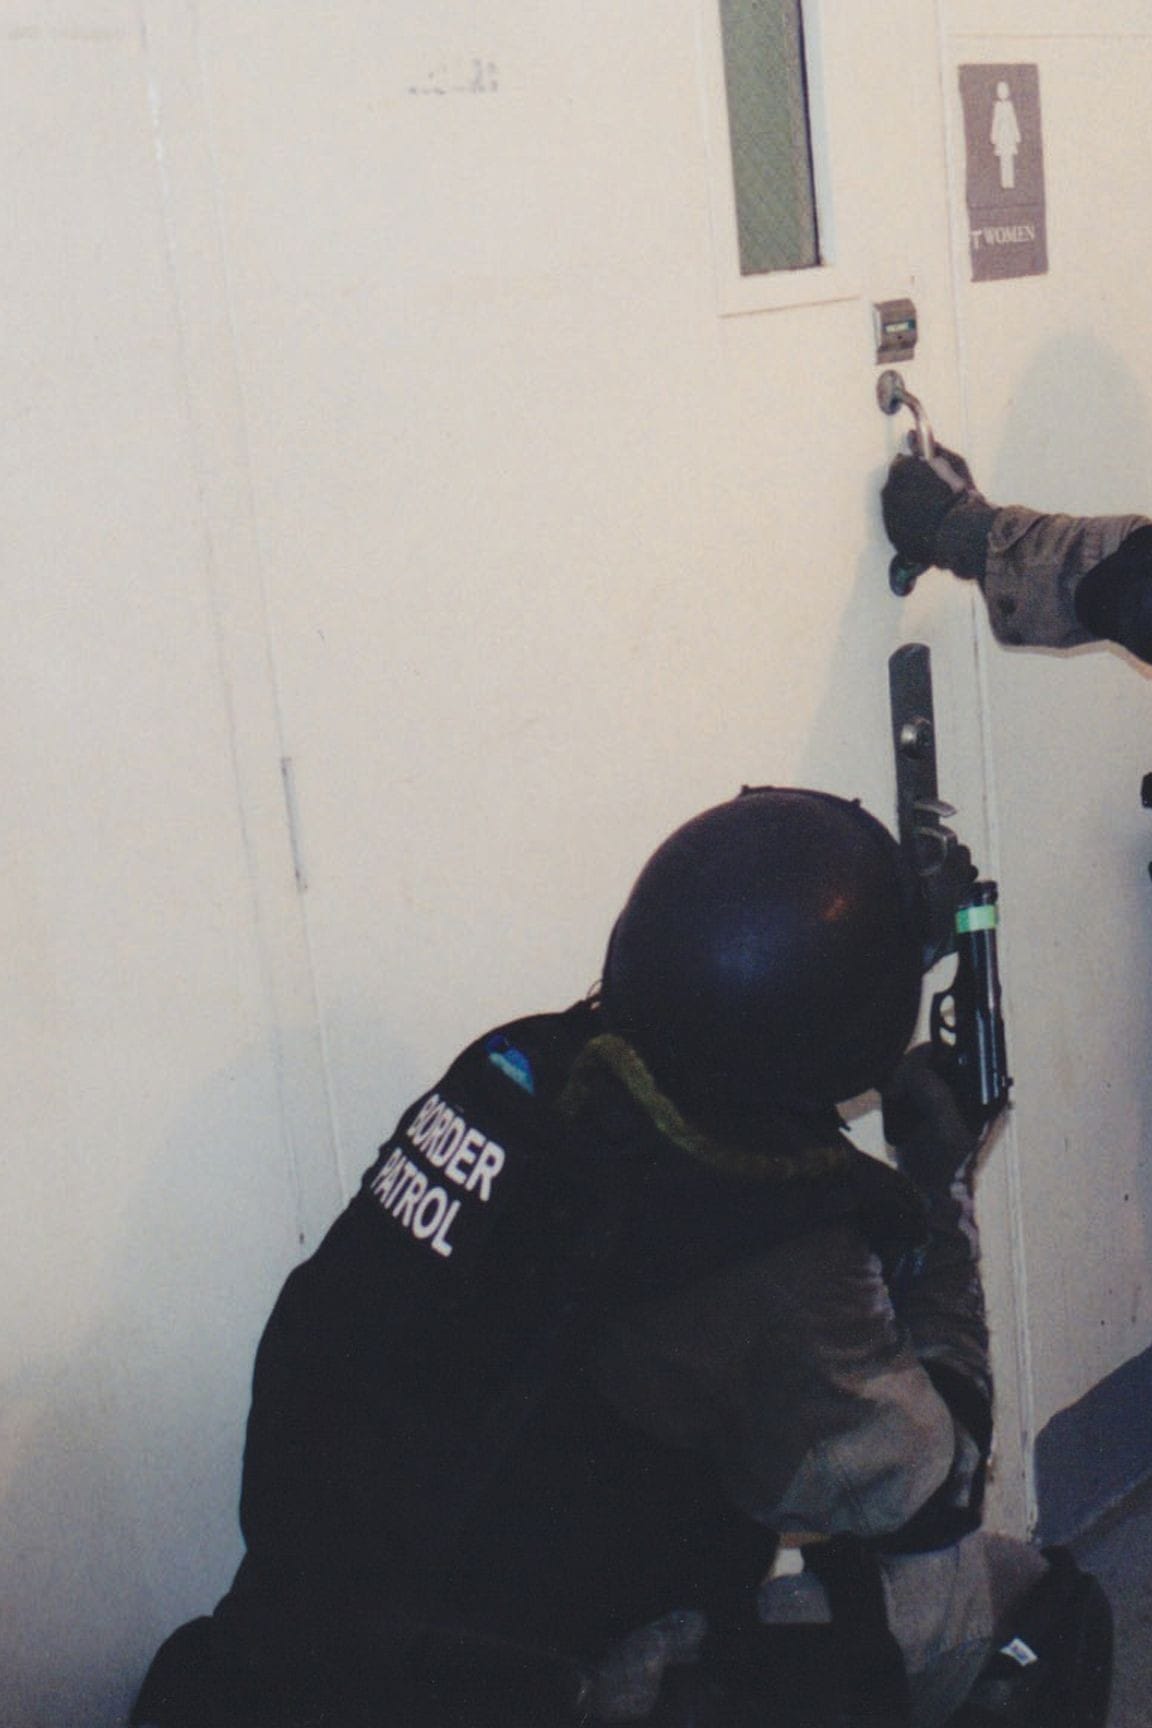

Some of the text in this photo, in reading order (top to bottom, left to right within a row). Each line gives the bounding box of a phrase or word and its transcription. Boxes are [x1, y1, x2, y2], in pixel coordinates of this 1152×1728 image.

[984, 225, 1035, 244] WOMEN
[406, 1093, 506, 1202] BORDER
[370, 1147, 462, 1258] PATROL
